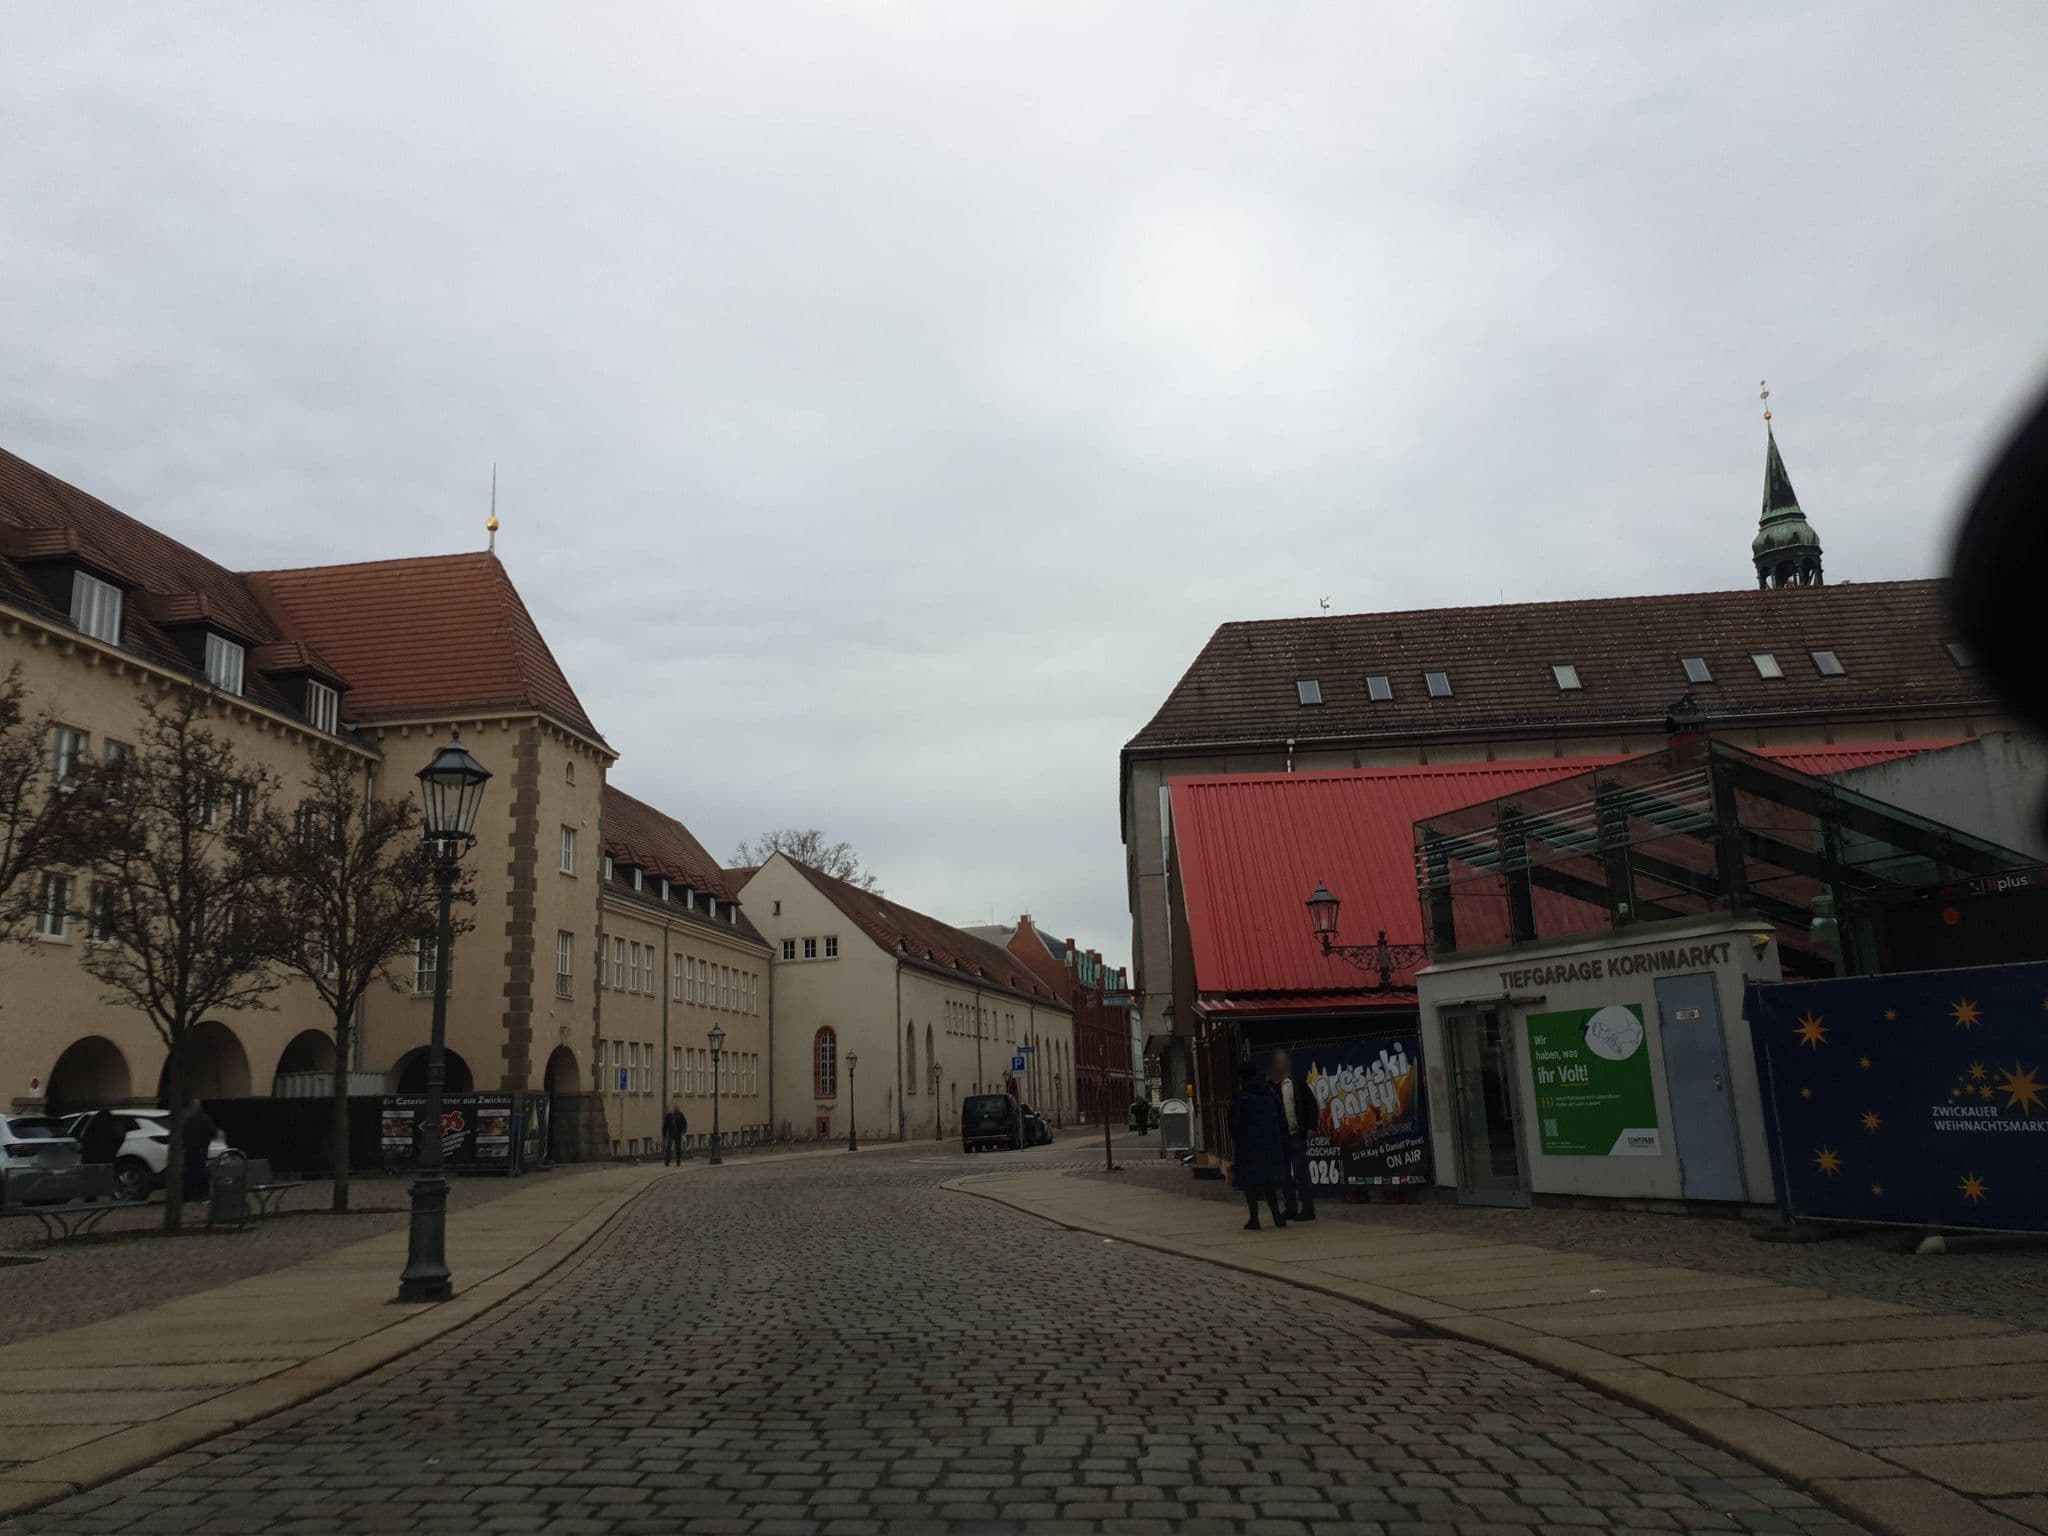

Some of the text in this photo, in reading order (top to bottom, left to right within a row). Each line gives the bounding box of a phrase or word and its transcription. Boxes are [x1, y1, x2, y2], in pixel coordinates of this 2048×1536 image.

[1500, 943, 1730, 990] TIEFGARAGE KORNMARKT
[1533, 1034, 1547, 1045] Wir
[1535, 1050, 1578, 1061] haben, was
[1014, 1058, 1022, 1069] P
[1538, 1064, 1589, 1083] ihr Volt!
[396, 1097, 427, 1105] Caterin
[477, 1096, 512, 1105] Zwickau
[1331, 1079, 1396, 1130] party
[1931, 1106, 1998, 1117] ZWICKAUER
[1386, 1149, 1422, 1168] ON AIR
[1308, 1159, 1339, 1184] 026
